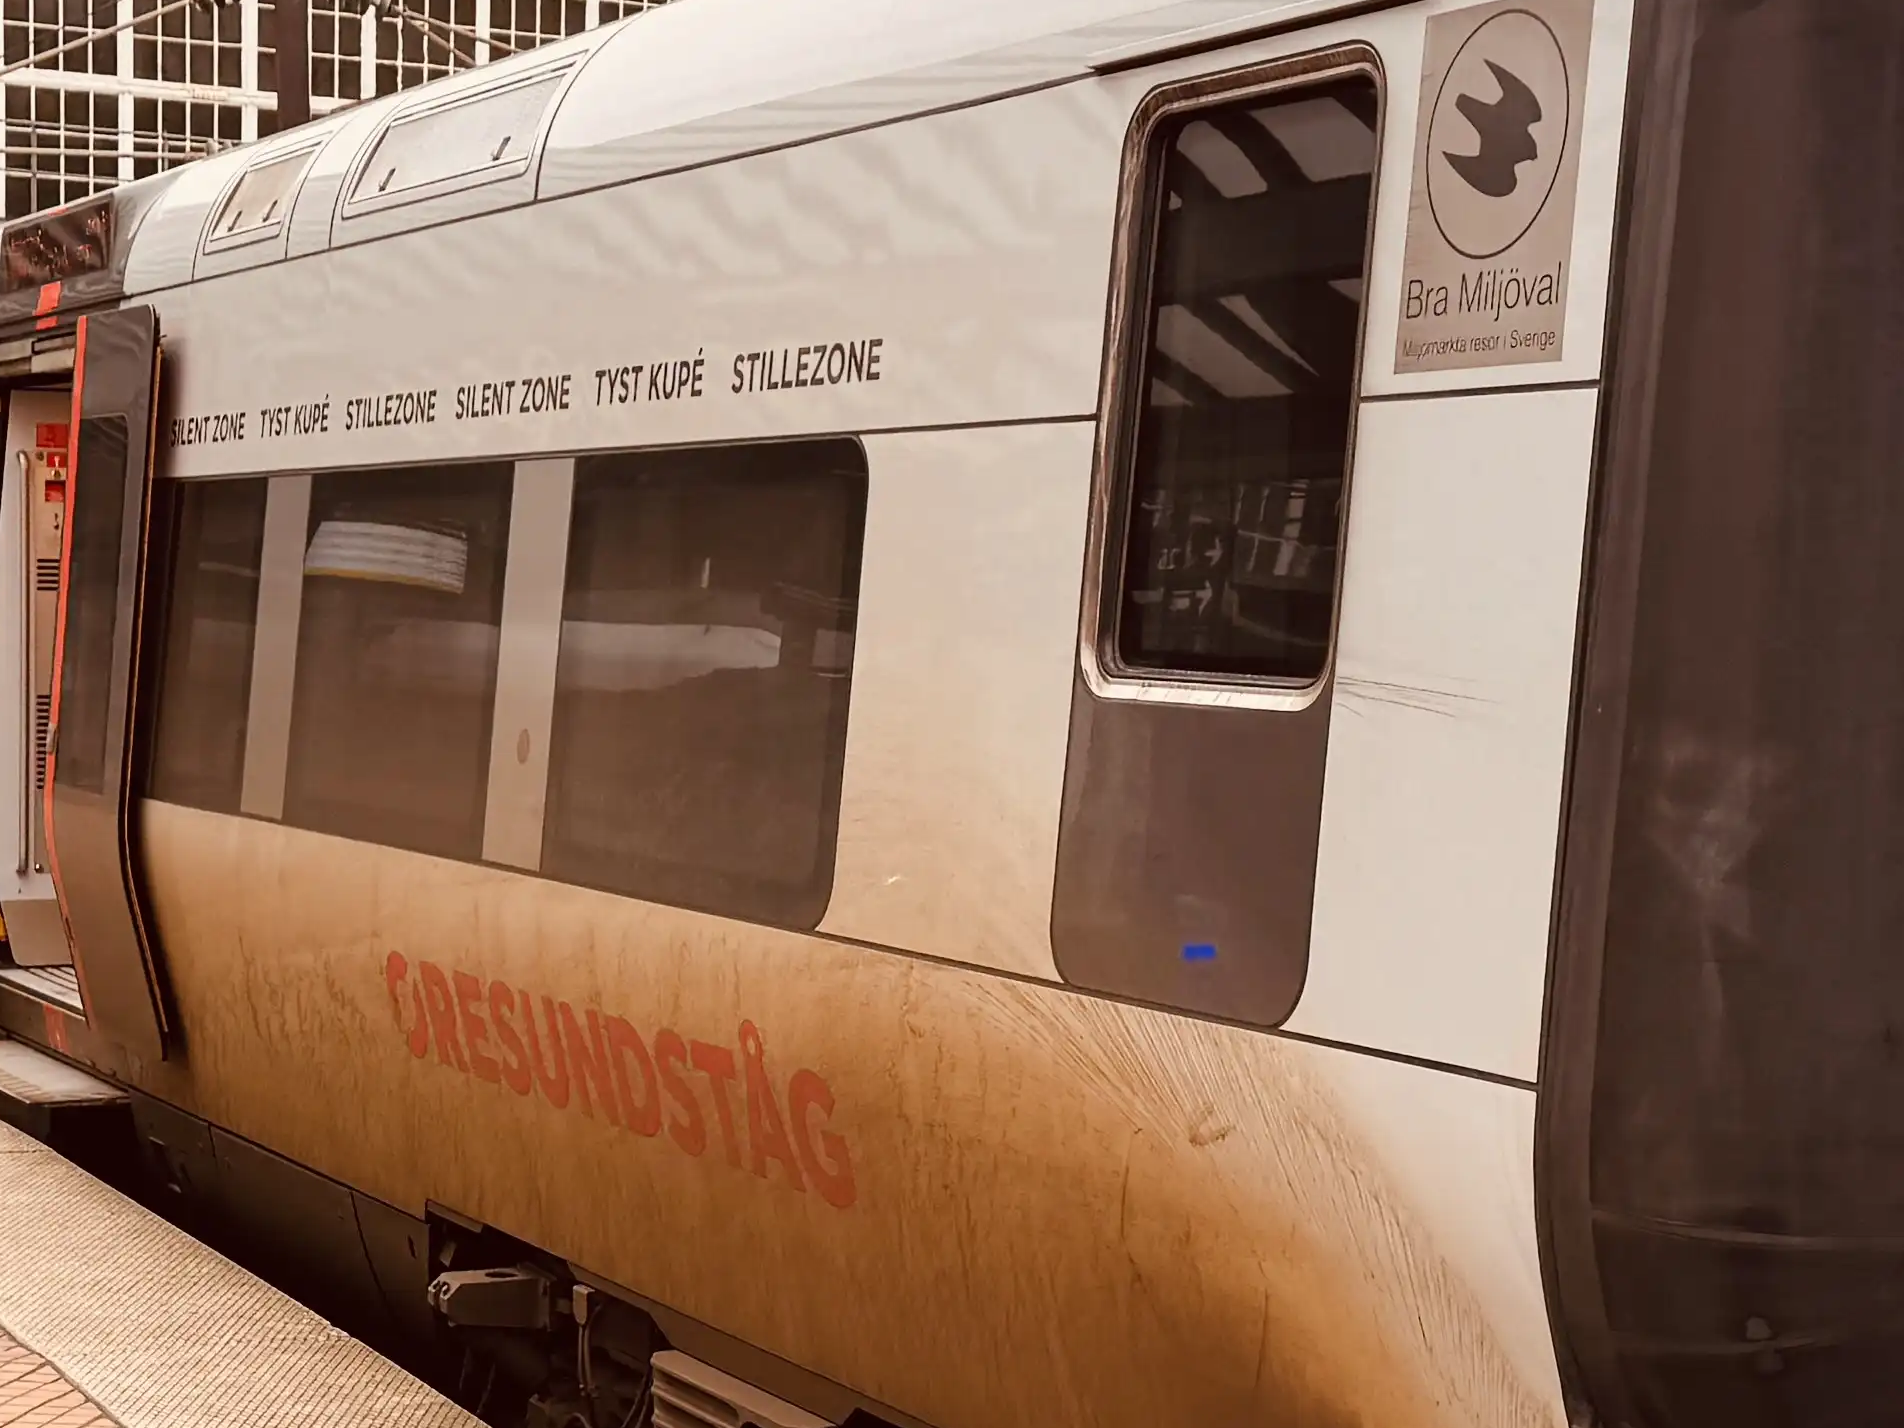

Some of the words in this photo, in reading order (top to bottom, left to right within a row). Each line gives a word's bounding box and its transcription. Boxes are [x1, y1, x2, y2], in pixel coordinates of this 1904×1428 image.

[1405, 278, 1449, 320] Bra
[1458, 261, 1562, 322] Miljöval
[170, 416, 210, 447] SILENT
[212, 412, 246, 443] ZONE
[260, 406, 291, 439] TYST
[295, 394, 330, 435] KUPÉ
[345, 389, 437, 431] STILLEZONE
[455, 379, 516, 420] SILENT
[519, 374, 571, 413] ZONE
[595, 365, 644, 407] TYST
[648, 347, 705, 401] KUPÉ
[731, 338, 884, 394] STILLEZONE
